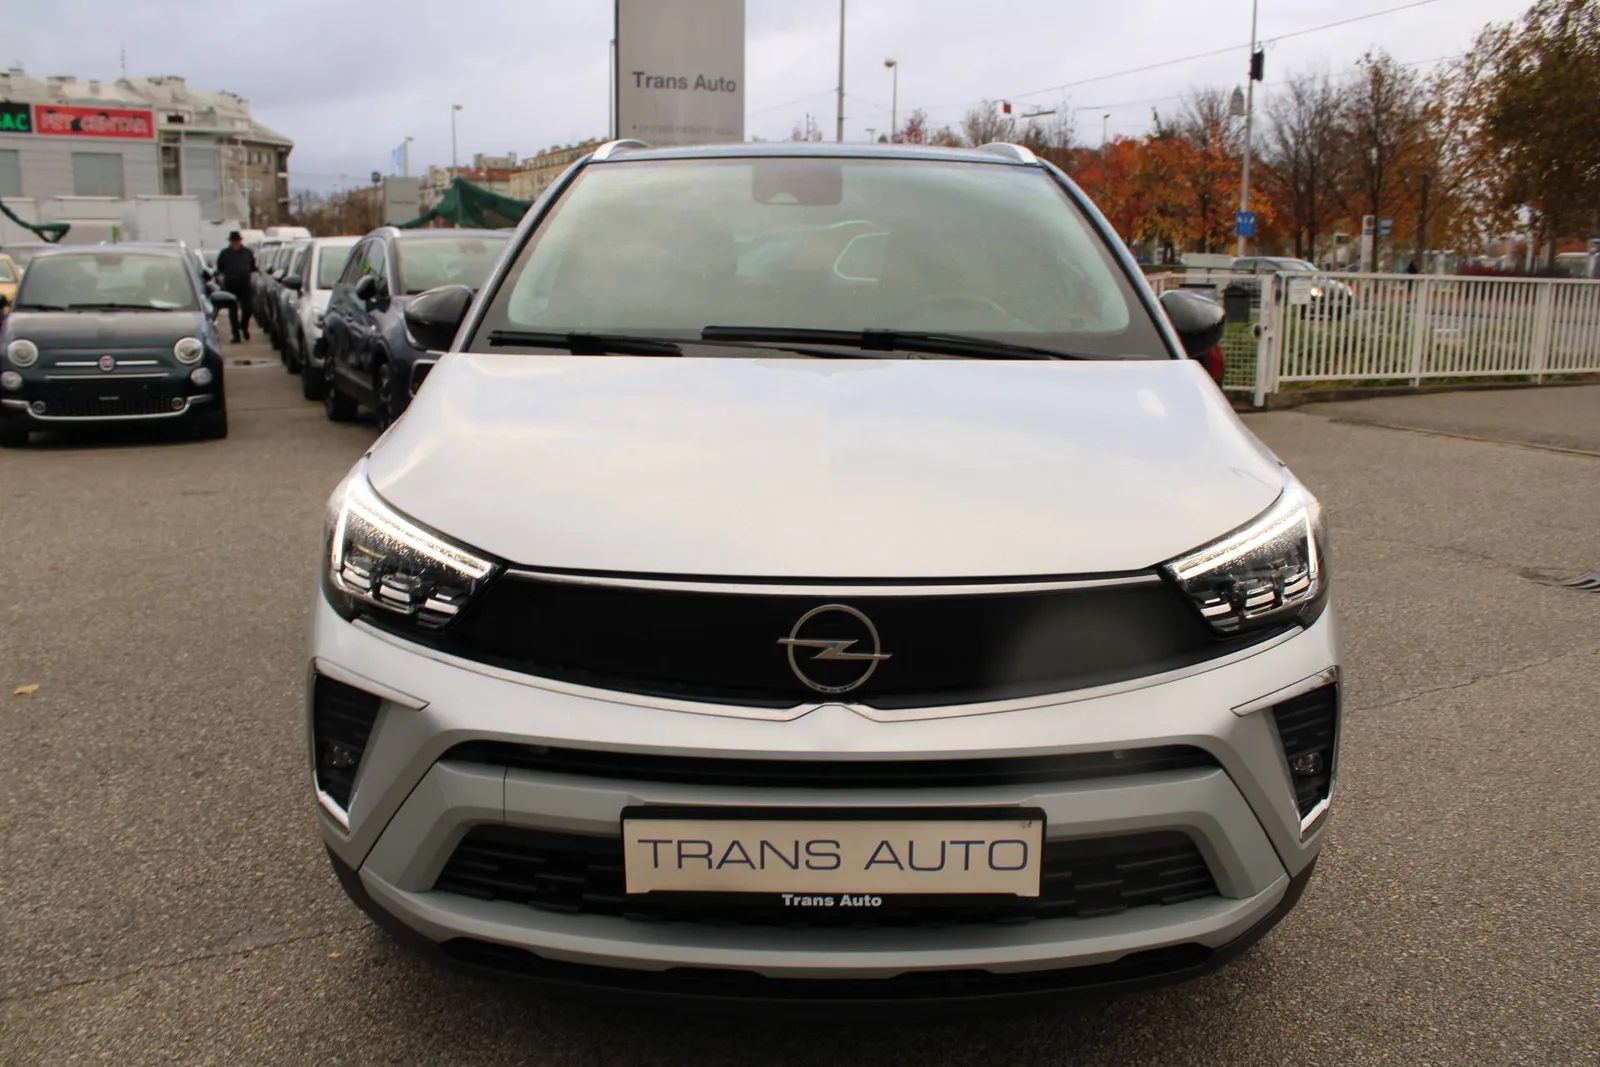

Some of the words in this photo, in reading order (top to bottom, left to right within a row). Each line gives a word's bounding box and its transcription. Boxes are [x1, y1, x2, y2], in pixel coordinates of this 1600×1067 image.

[632, 71, 688, 90] Trans
[694, 74, 737, 93] Auto
[0, 112, 29, 131] AC
[637, 839, 842, 871] TRANS
[863, 839, 1029, 872] AUTO
[781, 894, 835, 907] Trans
[839, 894, 882, 907] Auto
